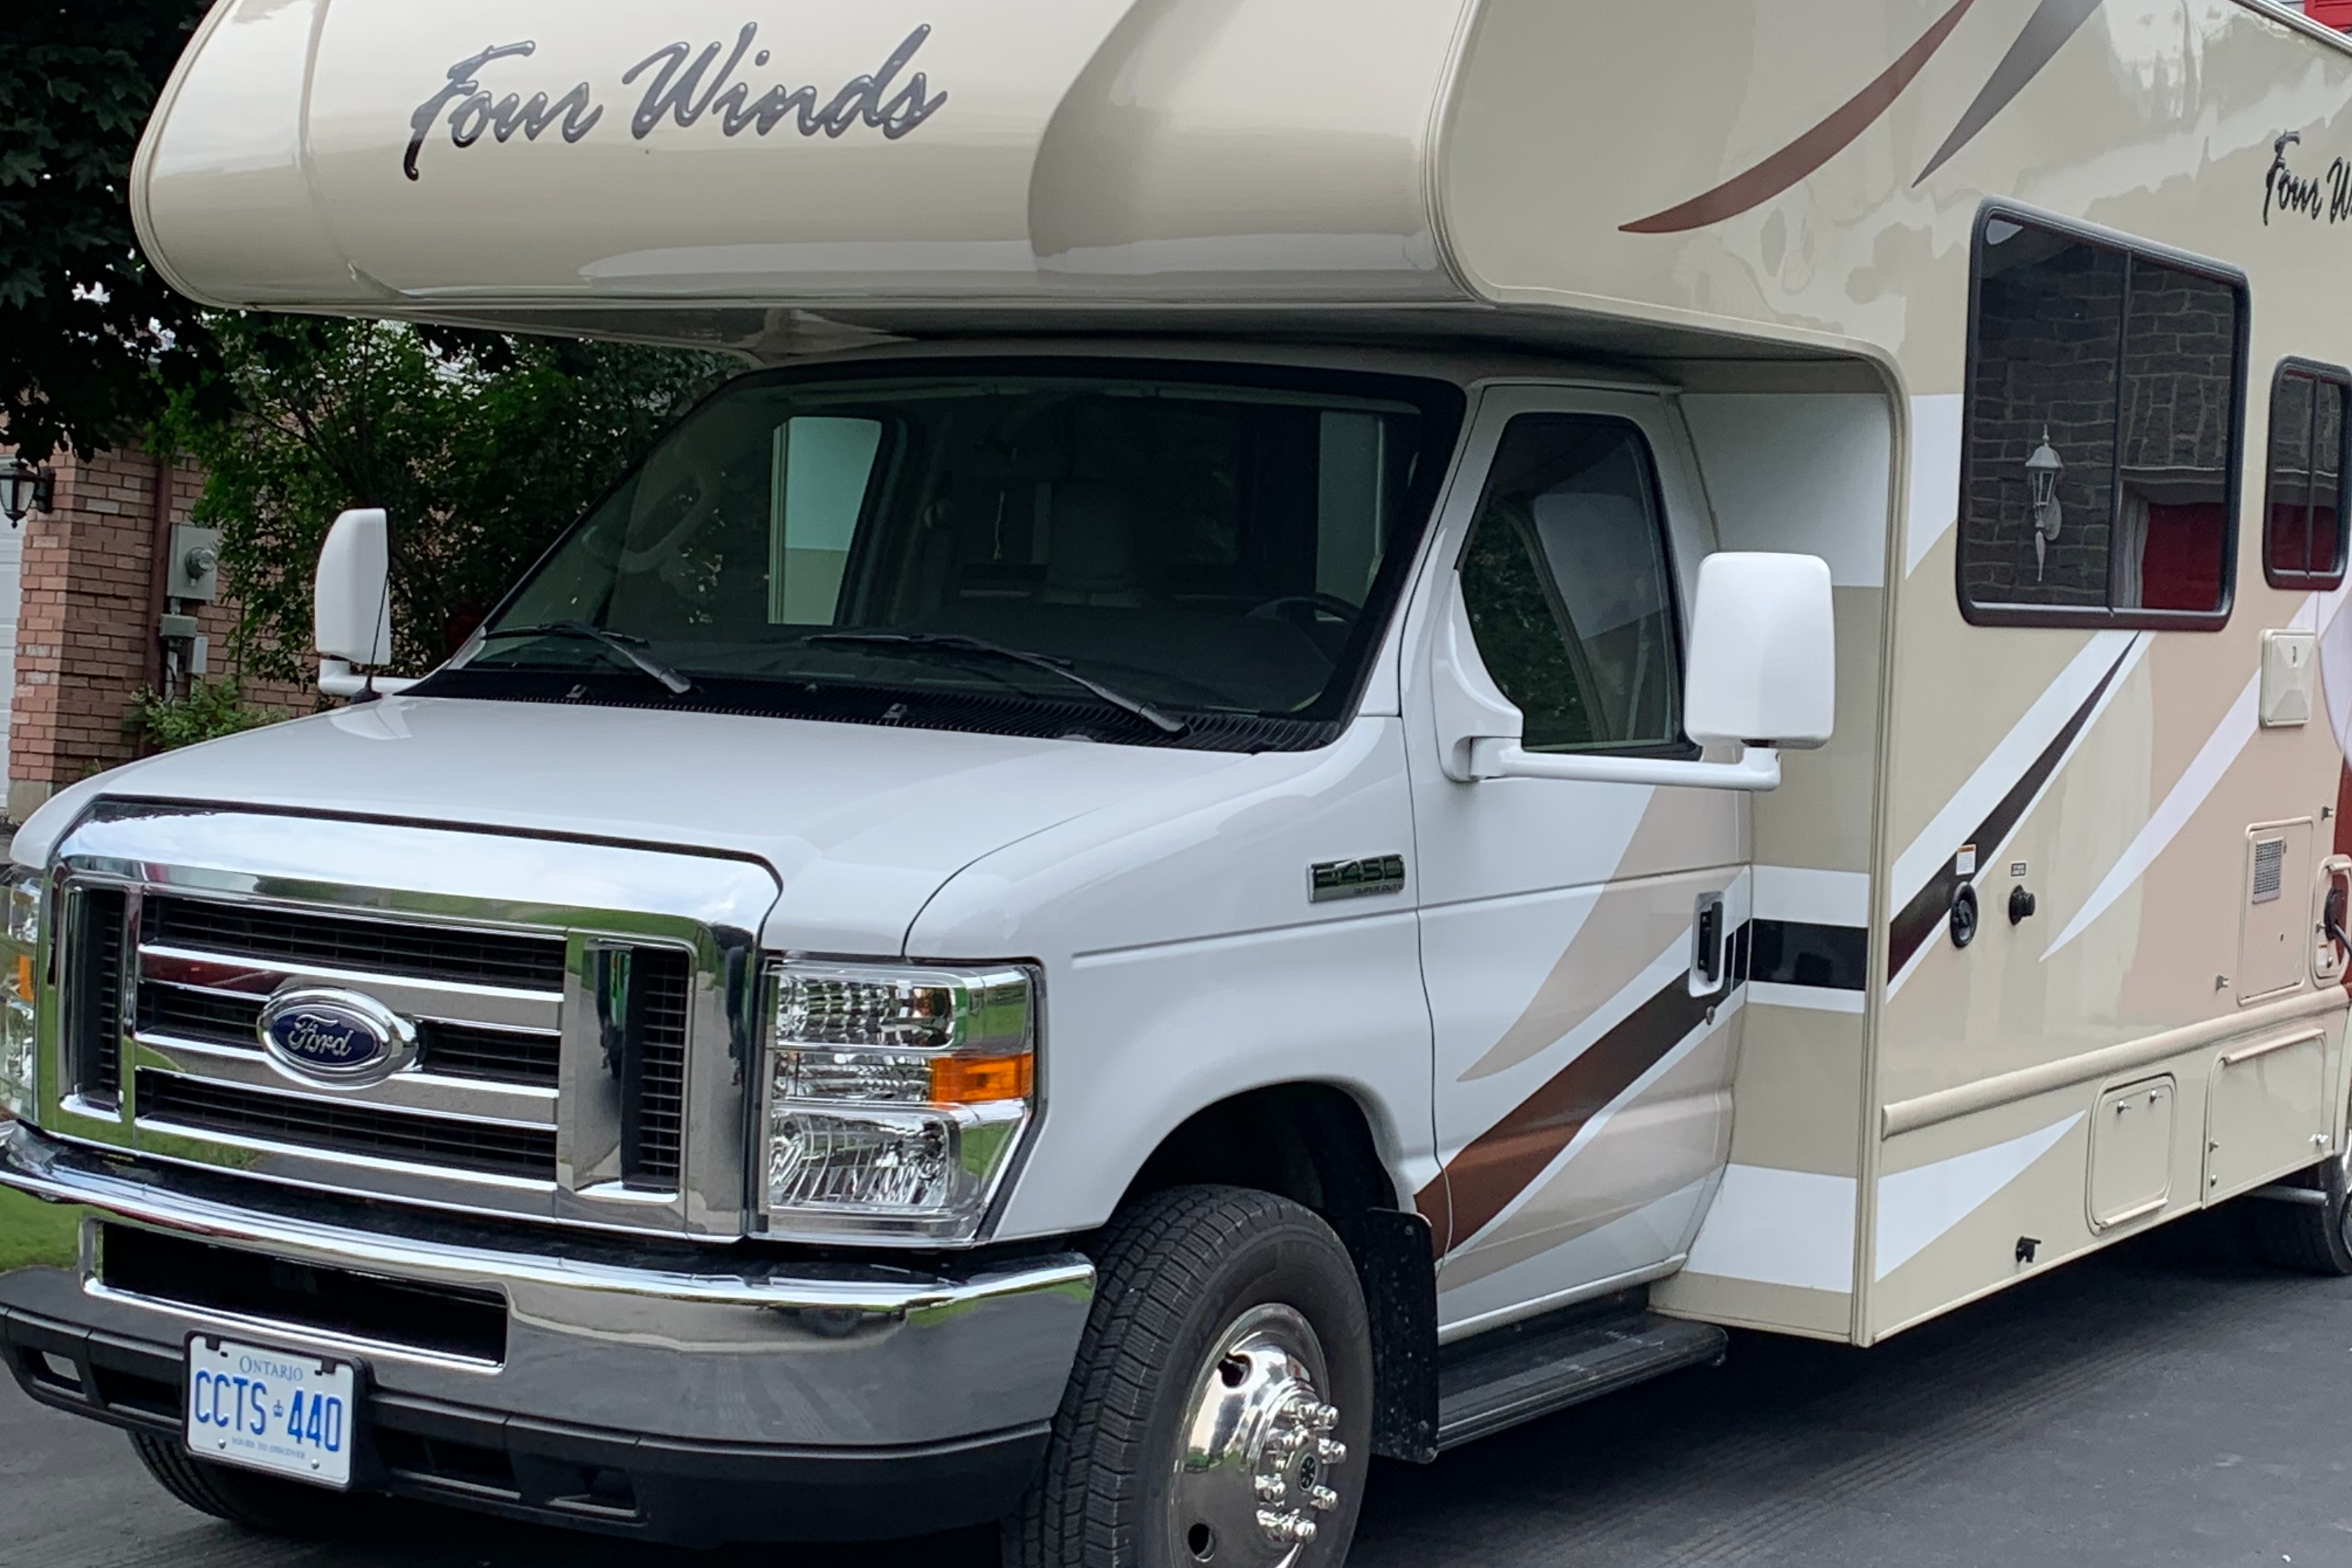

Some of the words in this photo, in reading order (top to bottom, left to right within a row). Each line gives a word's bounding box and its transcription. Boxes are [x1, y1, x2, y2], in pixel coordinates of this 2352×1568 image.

[403, 40, 603, 182] Four
[622, 21, 947, 140] Winds
[2263, 129, 2323, 227] Four
[287, 1014, 354, 1057] Ford
[239, 1355, 303, 1381] ONTARIO
[195, 1370, 268, 1435] CCTS
[287, 1389, 342, 1452] 440
